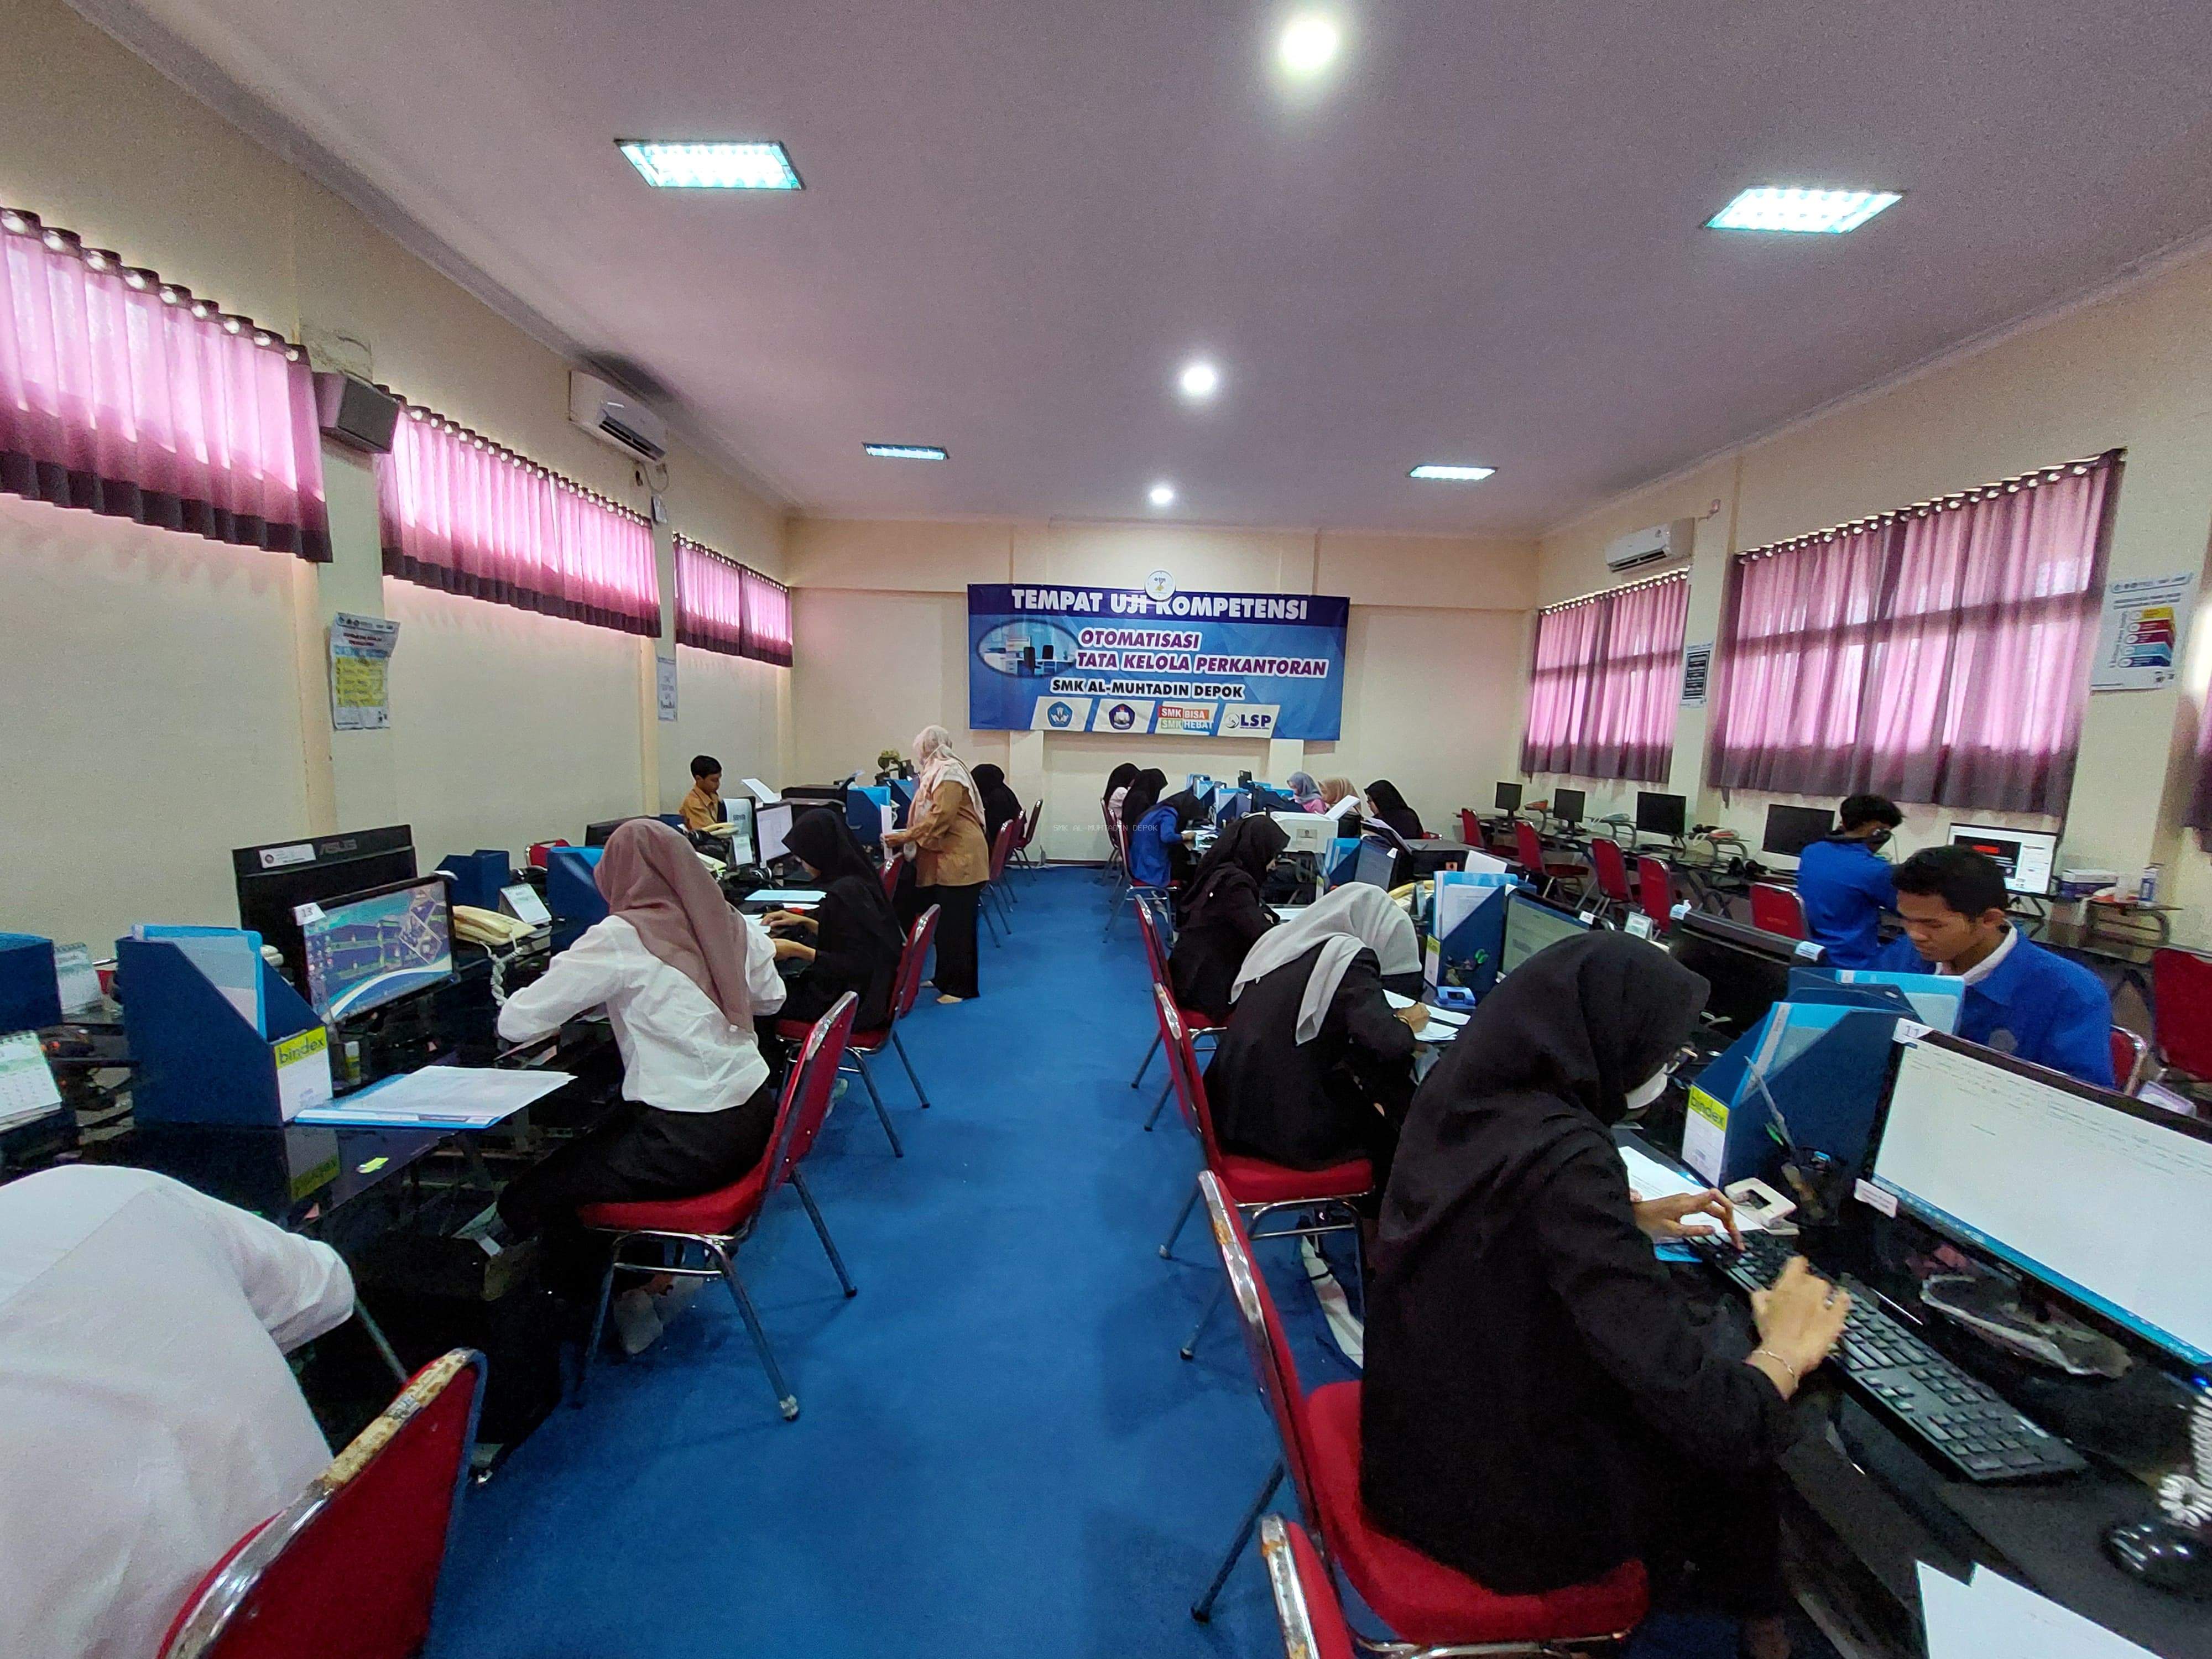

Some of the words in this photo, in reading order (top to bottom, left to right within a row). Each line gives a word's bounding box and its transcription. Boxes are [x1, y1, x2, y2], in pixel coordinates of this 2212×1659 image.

[1011, 589, 1103, 612] TEMPAT
[1110, 593, 1147, 614] UJI
[1156, 596, 1308, 620] KOMPETENSI
[1081, 629, 1200, 649] OTOMATISASI
[1078, 652, 1118, 668] TATA
[1123, 654, 1190, 671] KELOLA
[1195, 657, 1327, 676] PERKANTORAN
[1052, 679, 1084, 692] SMK
[1087, 681, 1189, 696] AL-MUHTADIN
[1194, 685, 1243, 698] DEPOK
[1161, 708, 1182, 718] SMK
[1184, 710, 1205, 719] BISA
[1240, 714, 1271, 727] LSP
[1161, 719, 1182, 729] SMK
[1183, 721, 1213, 729] HEBAT
[301, 906, 314, 917] 13
[278, 1035, 325, 1064] bindex
[1691, 1089, 1725, 1127] bindex
